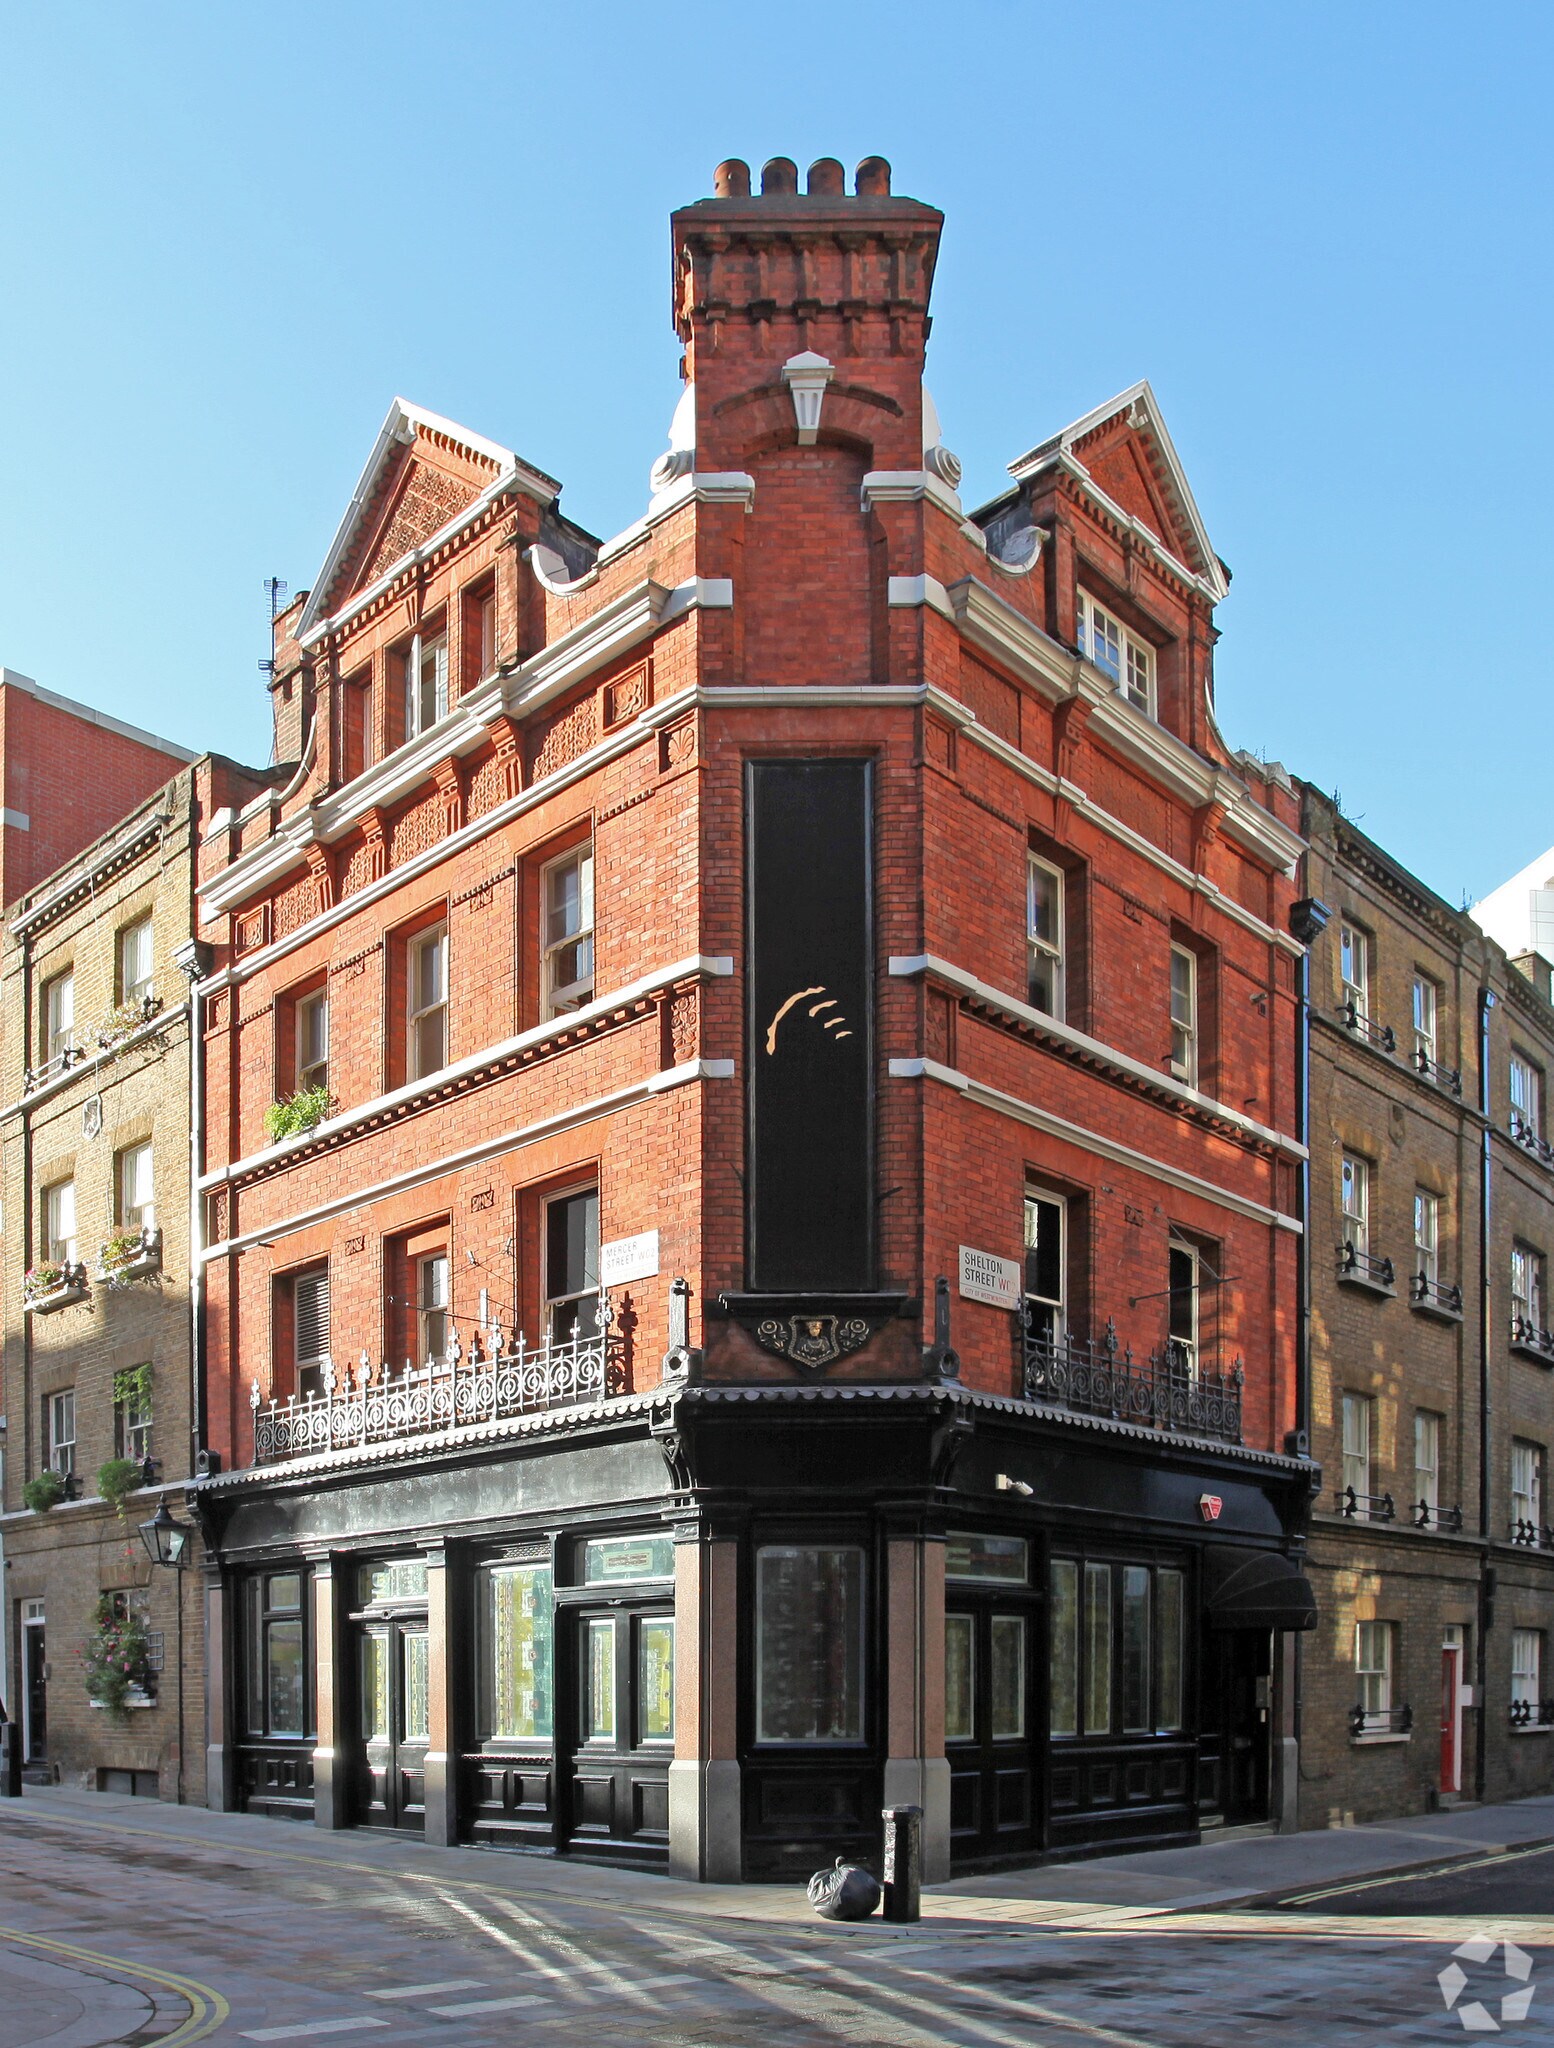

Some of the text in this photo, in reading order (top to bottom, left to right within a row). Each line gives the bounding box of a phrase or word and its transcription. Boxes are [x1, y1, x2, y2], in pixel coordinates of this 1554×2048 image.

[606, 1241, 638, 1258] MERCER
[606, 1253, 634, 1270] STREET
[964, 1252, 1003, 1275] SHELTON
[964, 1267, 996, 1288] STREET
[964, 1287, 974, 1296] CITY
